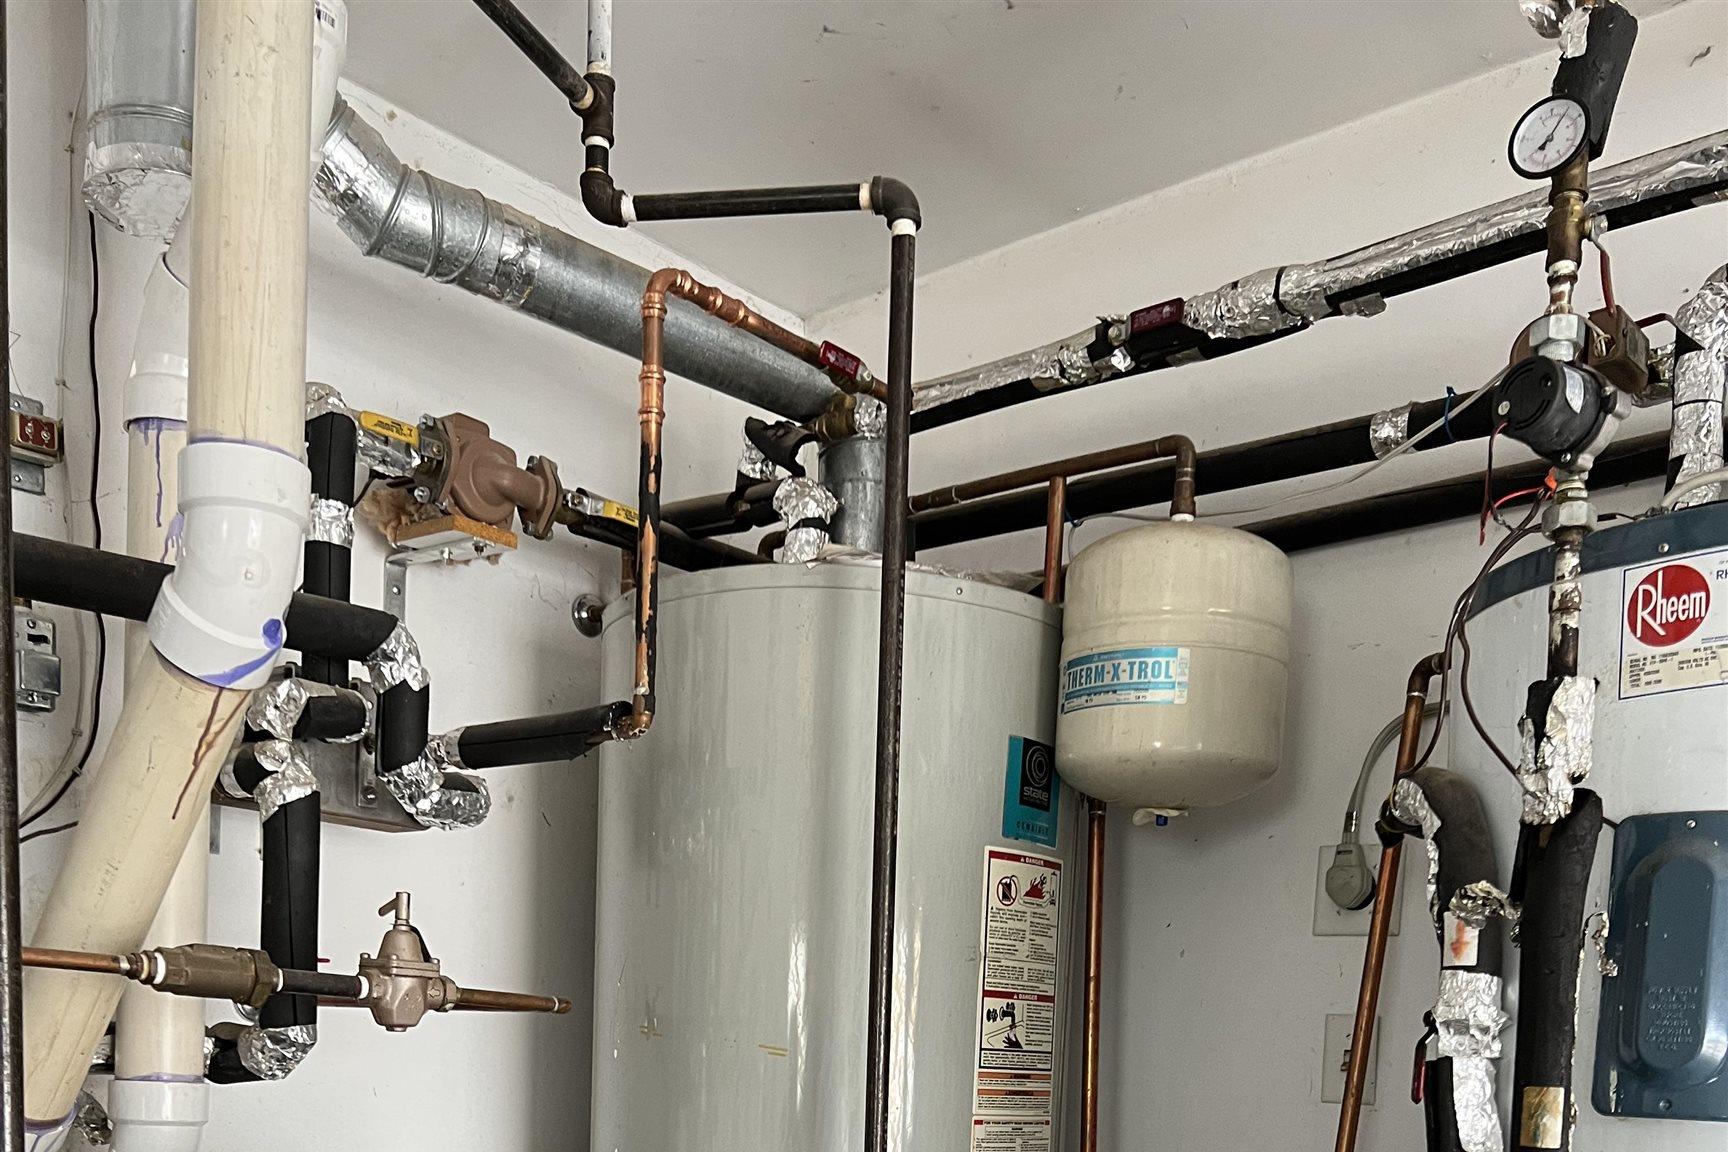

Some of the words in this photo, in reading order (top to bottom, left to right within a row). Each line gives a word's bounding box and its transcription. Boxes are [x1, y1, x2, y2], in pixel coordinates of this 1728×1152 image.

[1636, 570, 1706, 638] Rheem
[1067, 660, 1173, 690] THERM-X-TROL
[1024, 786, 1048, 801] state
